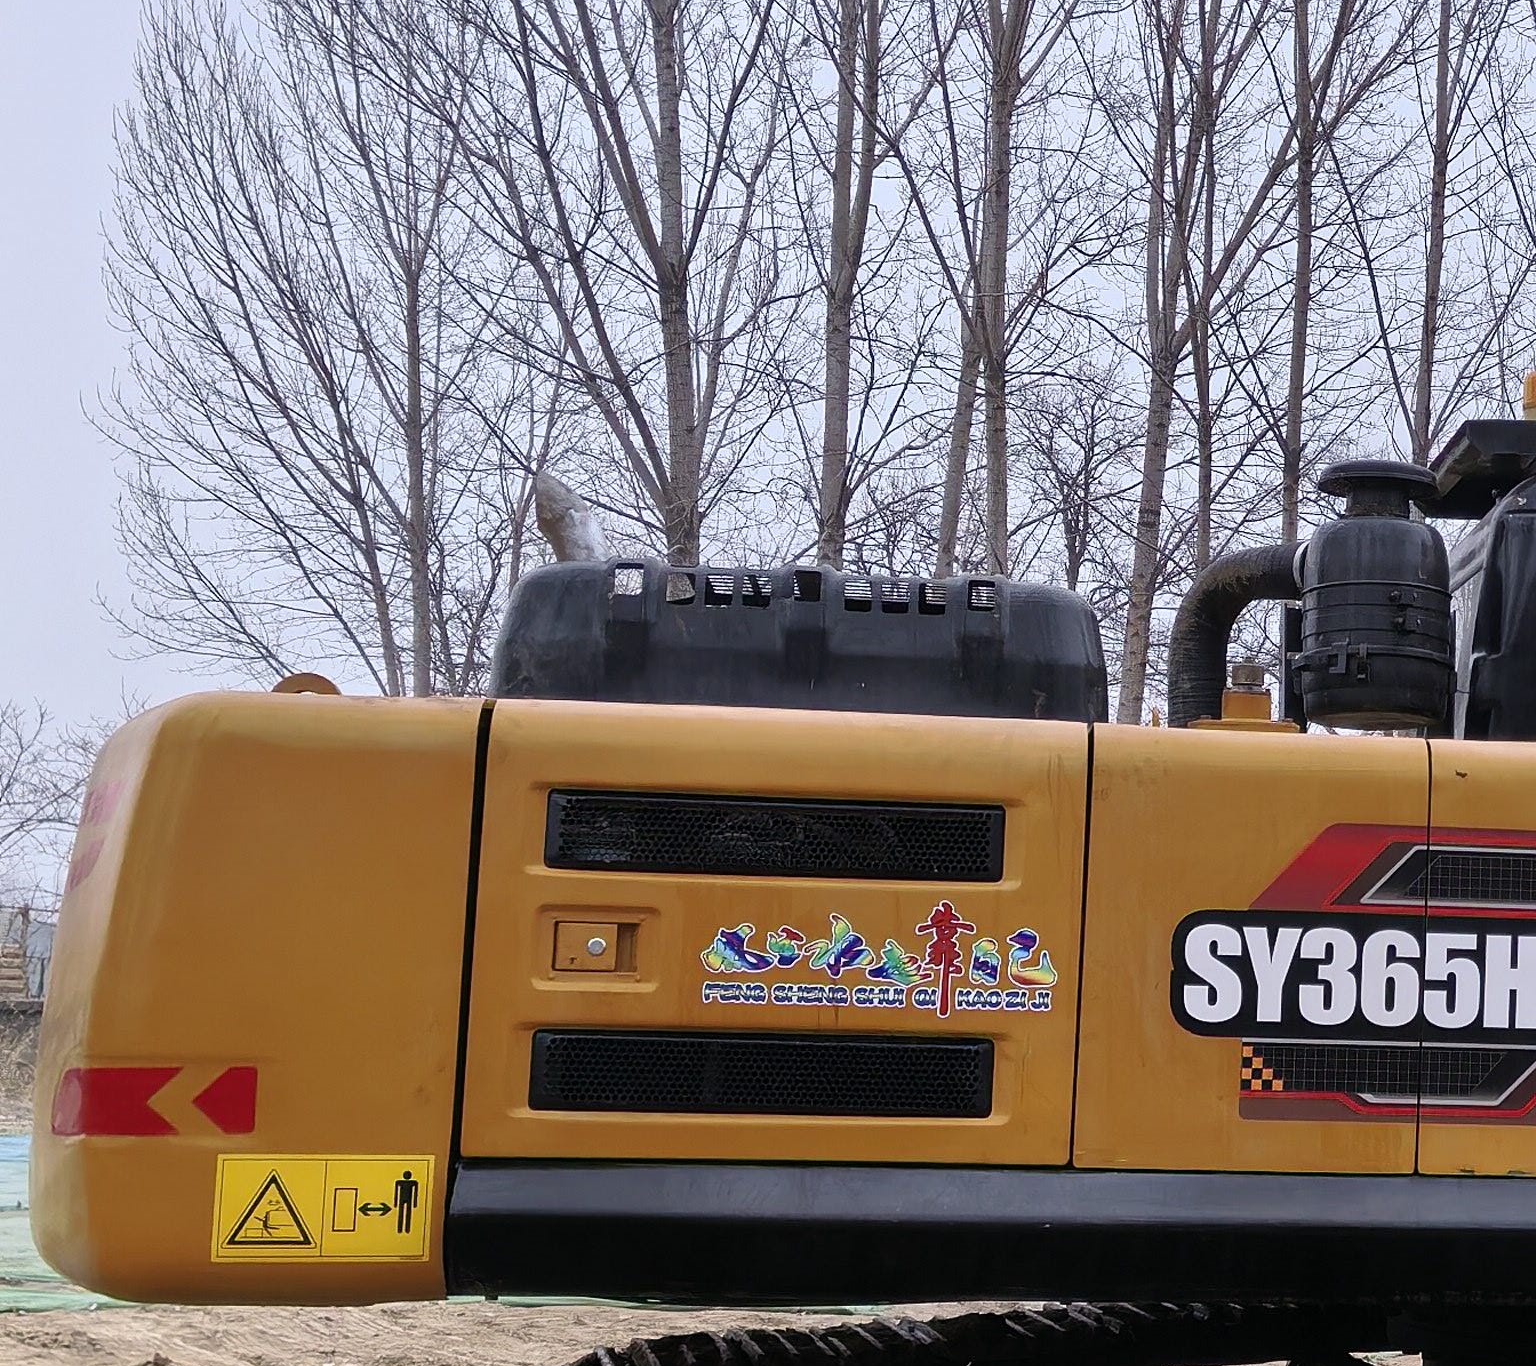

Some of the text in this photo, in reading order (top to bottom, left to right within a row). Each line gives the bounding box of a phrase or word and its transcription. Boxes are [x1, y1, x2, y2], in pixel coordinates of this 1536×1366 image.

[702, 982, 1051, 1012] FENG SHENG SHUI QI KAO ZI JI
